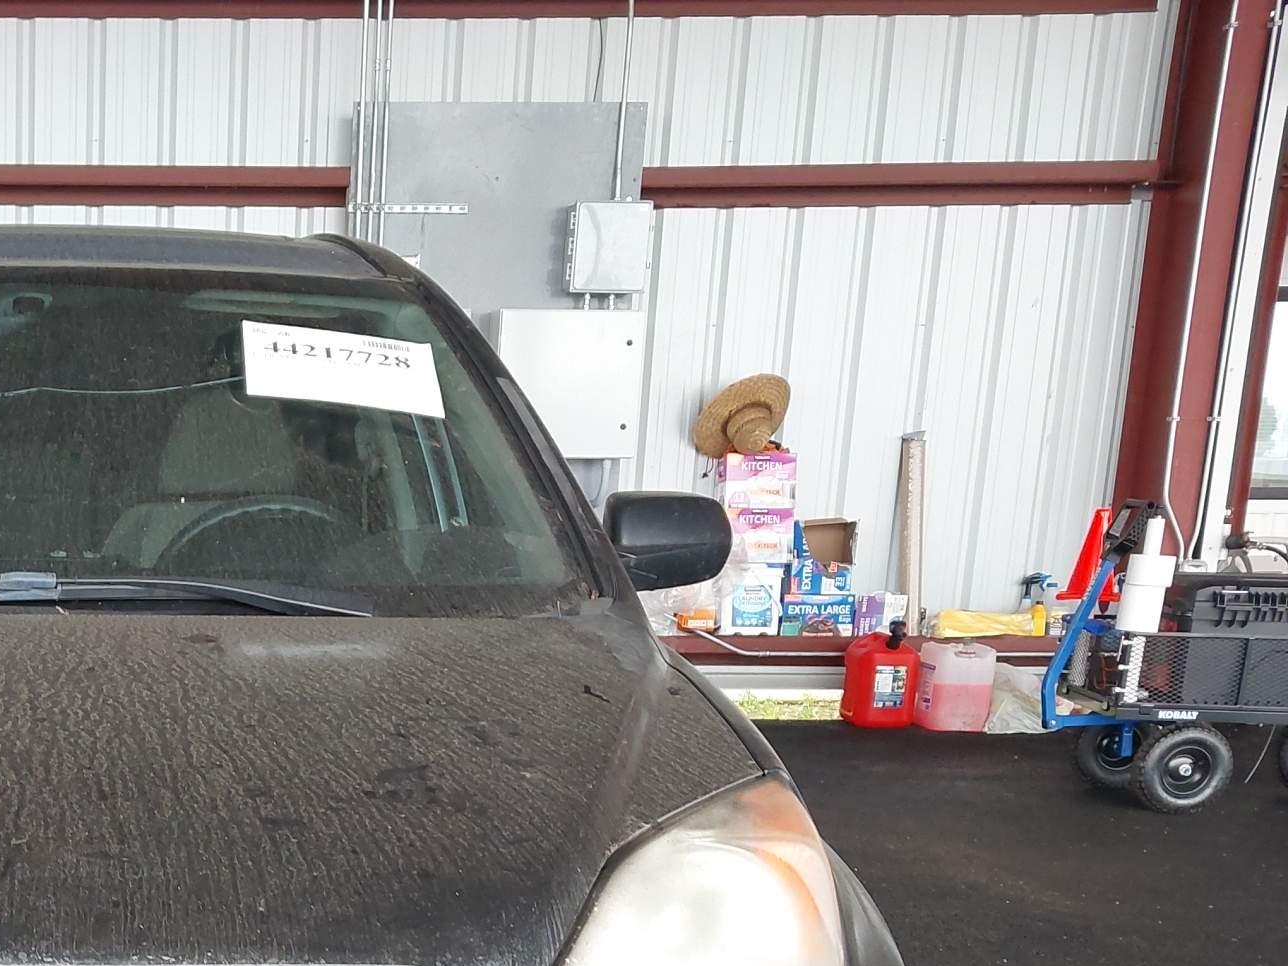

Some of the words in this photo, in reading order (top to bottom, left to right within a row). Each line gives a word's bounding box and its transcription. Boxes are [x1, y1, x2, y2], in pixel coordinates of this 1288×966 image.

[263, 341, 411, 369] 44217728
[742, 461, 783, 471] KITCHEN
[740, 514, 781, 524] KITCHEN
[802, 558, 813, 591] EXTRA
[788, 604, 819, 615] EXTRA
[821, 604, 851, 615] LARGE
[1158, 710, 1199, 720] KOBALT
